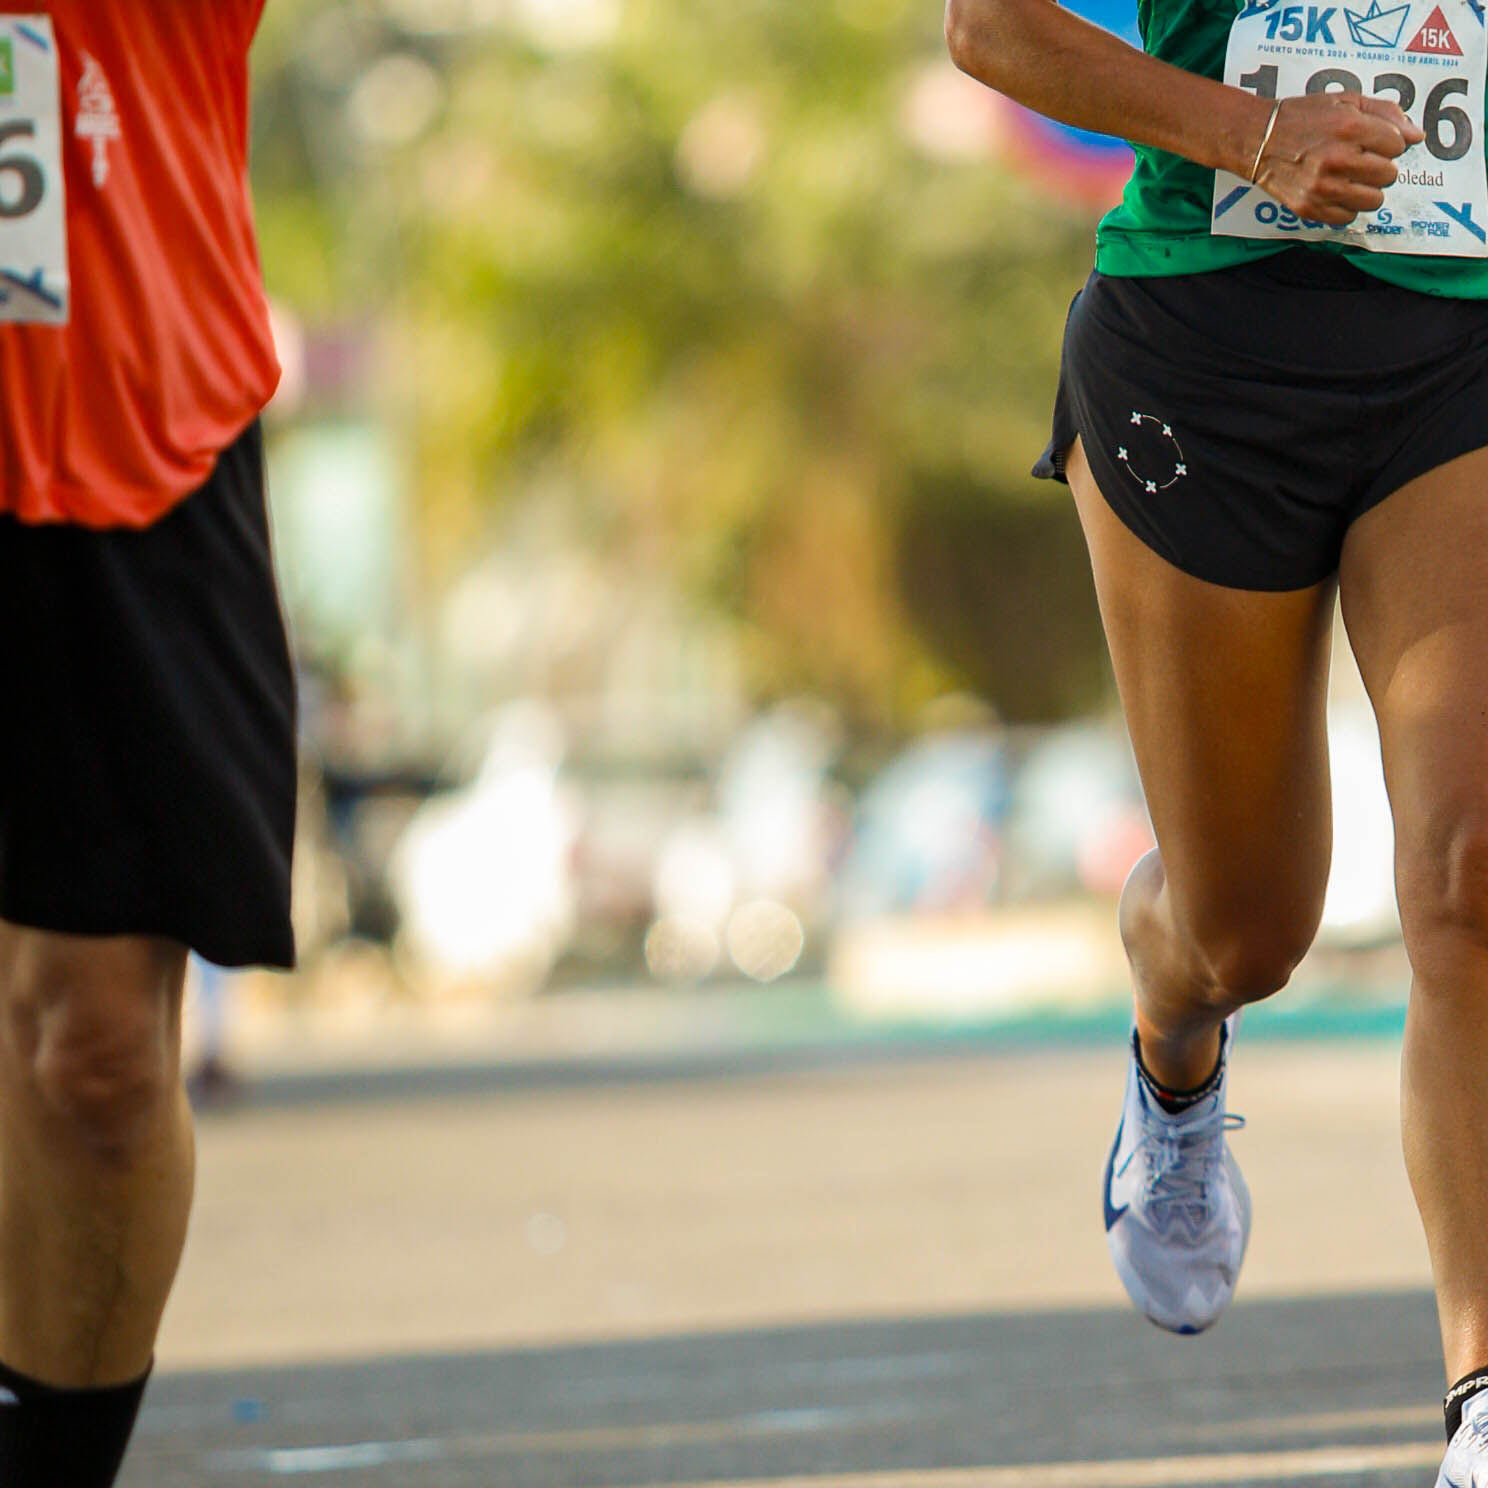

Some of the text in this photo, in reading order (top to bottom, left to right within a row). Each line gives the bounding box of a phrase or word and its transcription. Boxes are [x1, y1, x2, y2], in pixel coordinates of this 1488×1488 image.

[1264, 6, 1338, 45] 15K
[1420, 27, 1451, 49] 15K
[1257, 43, 1293, 54] PUERTO
[1295, 47, 1325, 57] NORTE
[1327, 49, 1347, 58] 2026
[1356, 51, 1391, 61] ROSARIO
[1398, 169, 1444, 187] oledad
[1255, 201, 1348, 231] OS
